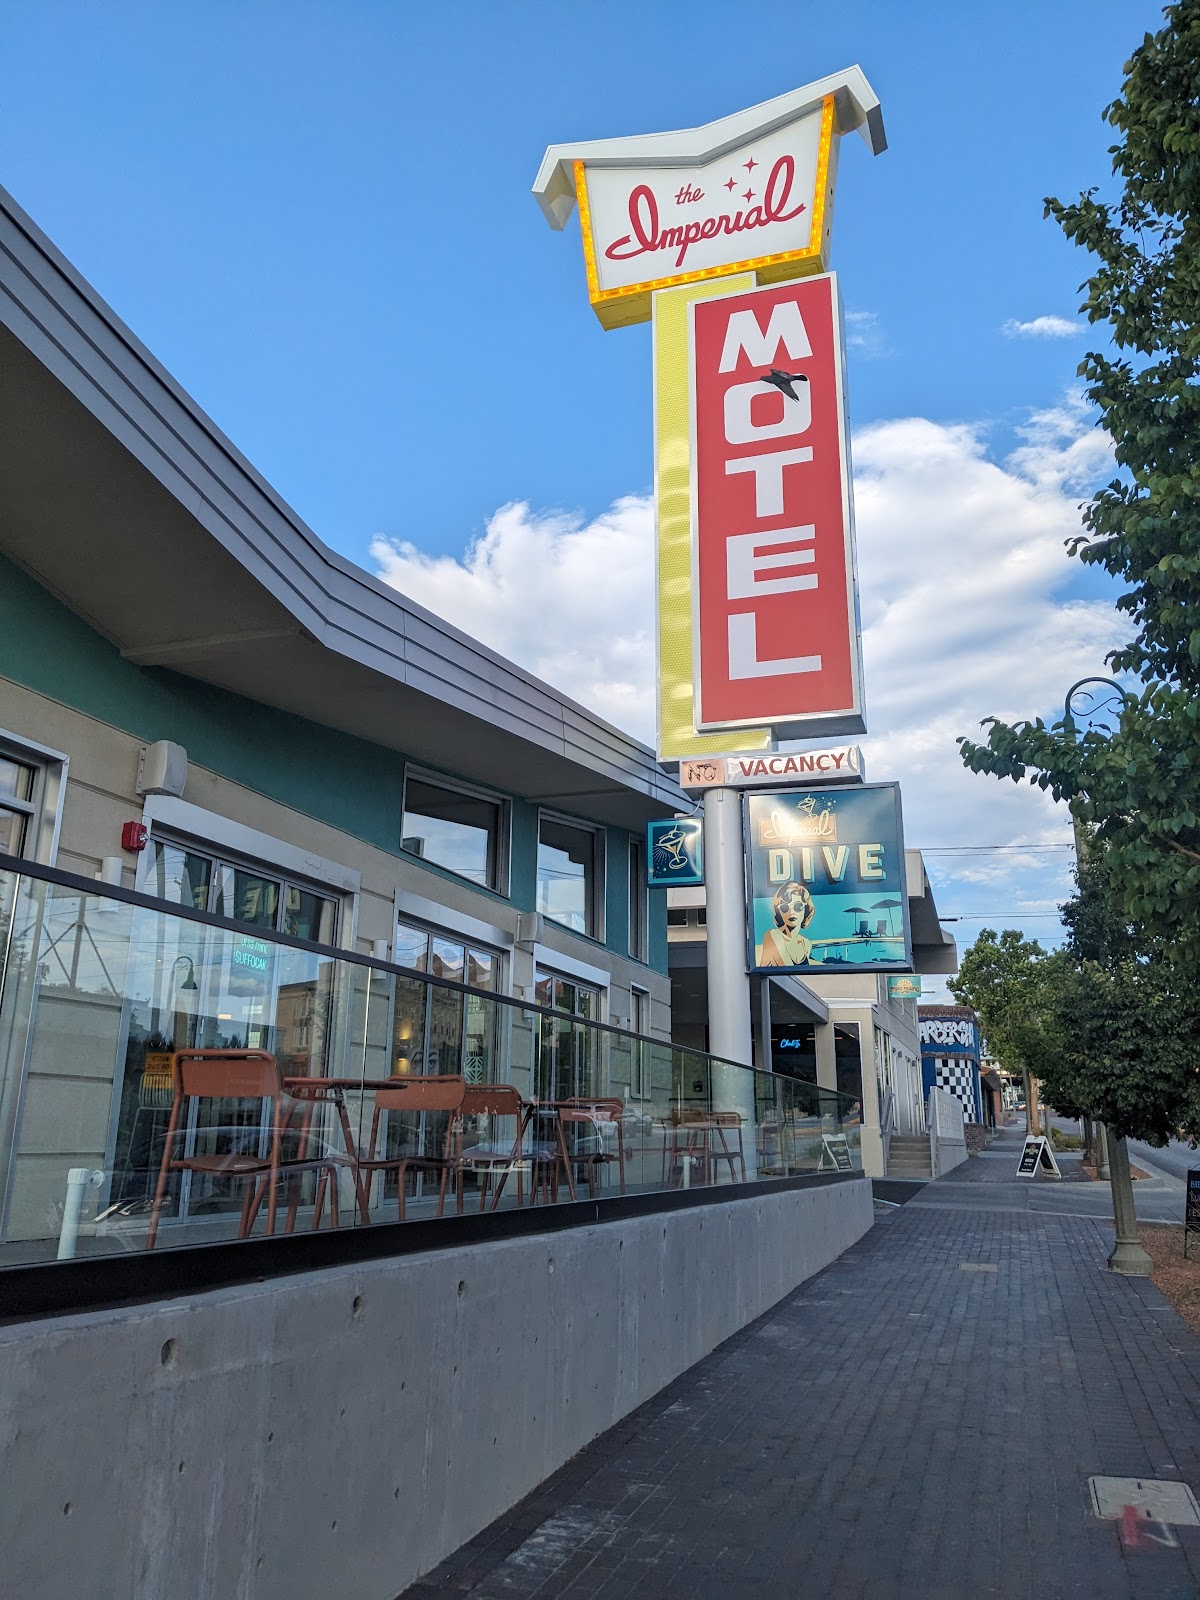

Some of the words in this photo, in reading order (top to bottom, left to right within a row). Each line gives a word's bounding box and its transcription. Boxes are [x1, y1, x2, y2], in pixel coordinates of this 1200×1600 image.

[604, 155, 806, 268] Imperial
[674, 183, 706, 205] the
[717, 300, 823, 681] MOTEL
[687, 763, 717, 783] NO
[738, 752, 845, 777] VACANCY
[768, 843, 886, 884] DIVE
